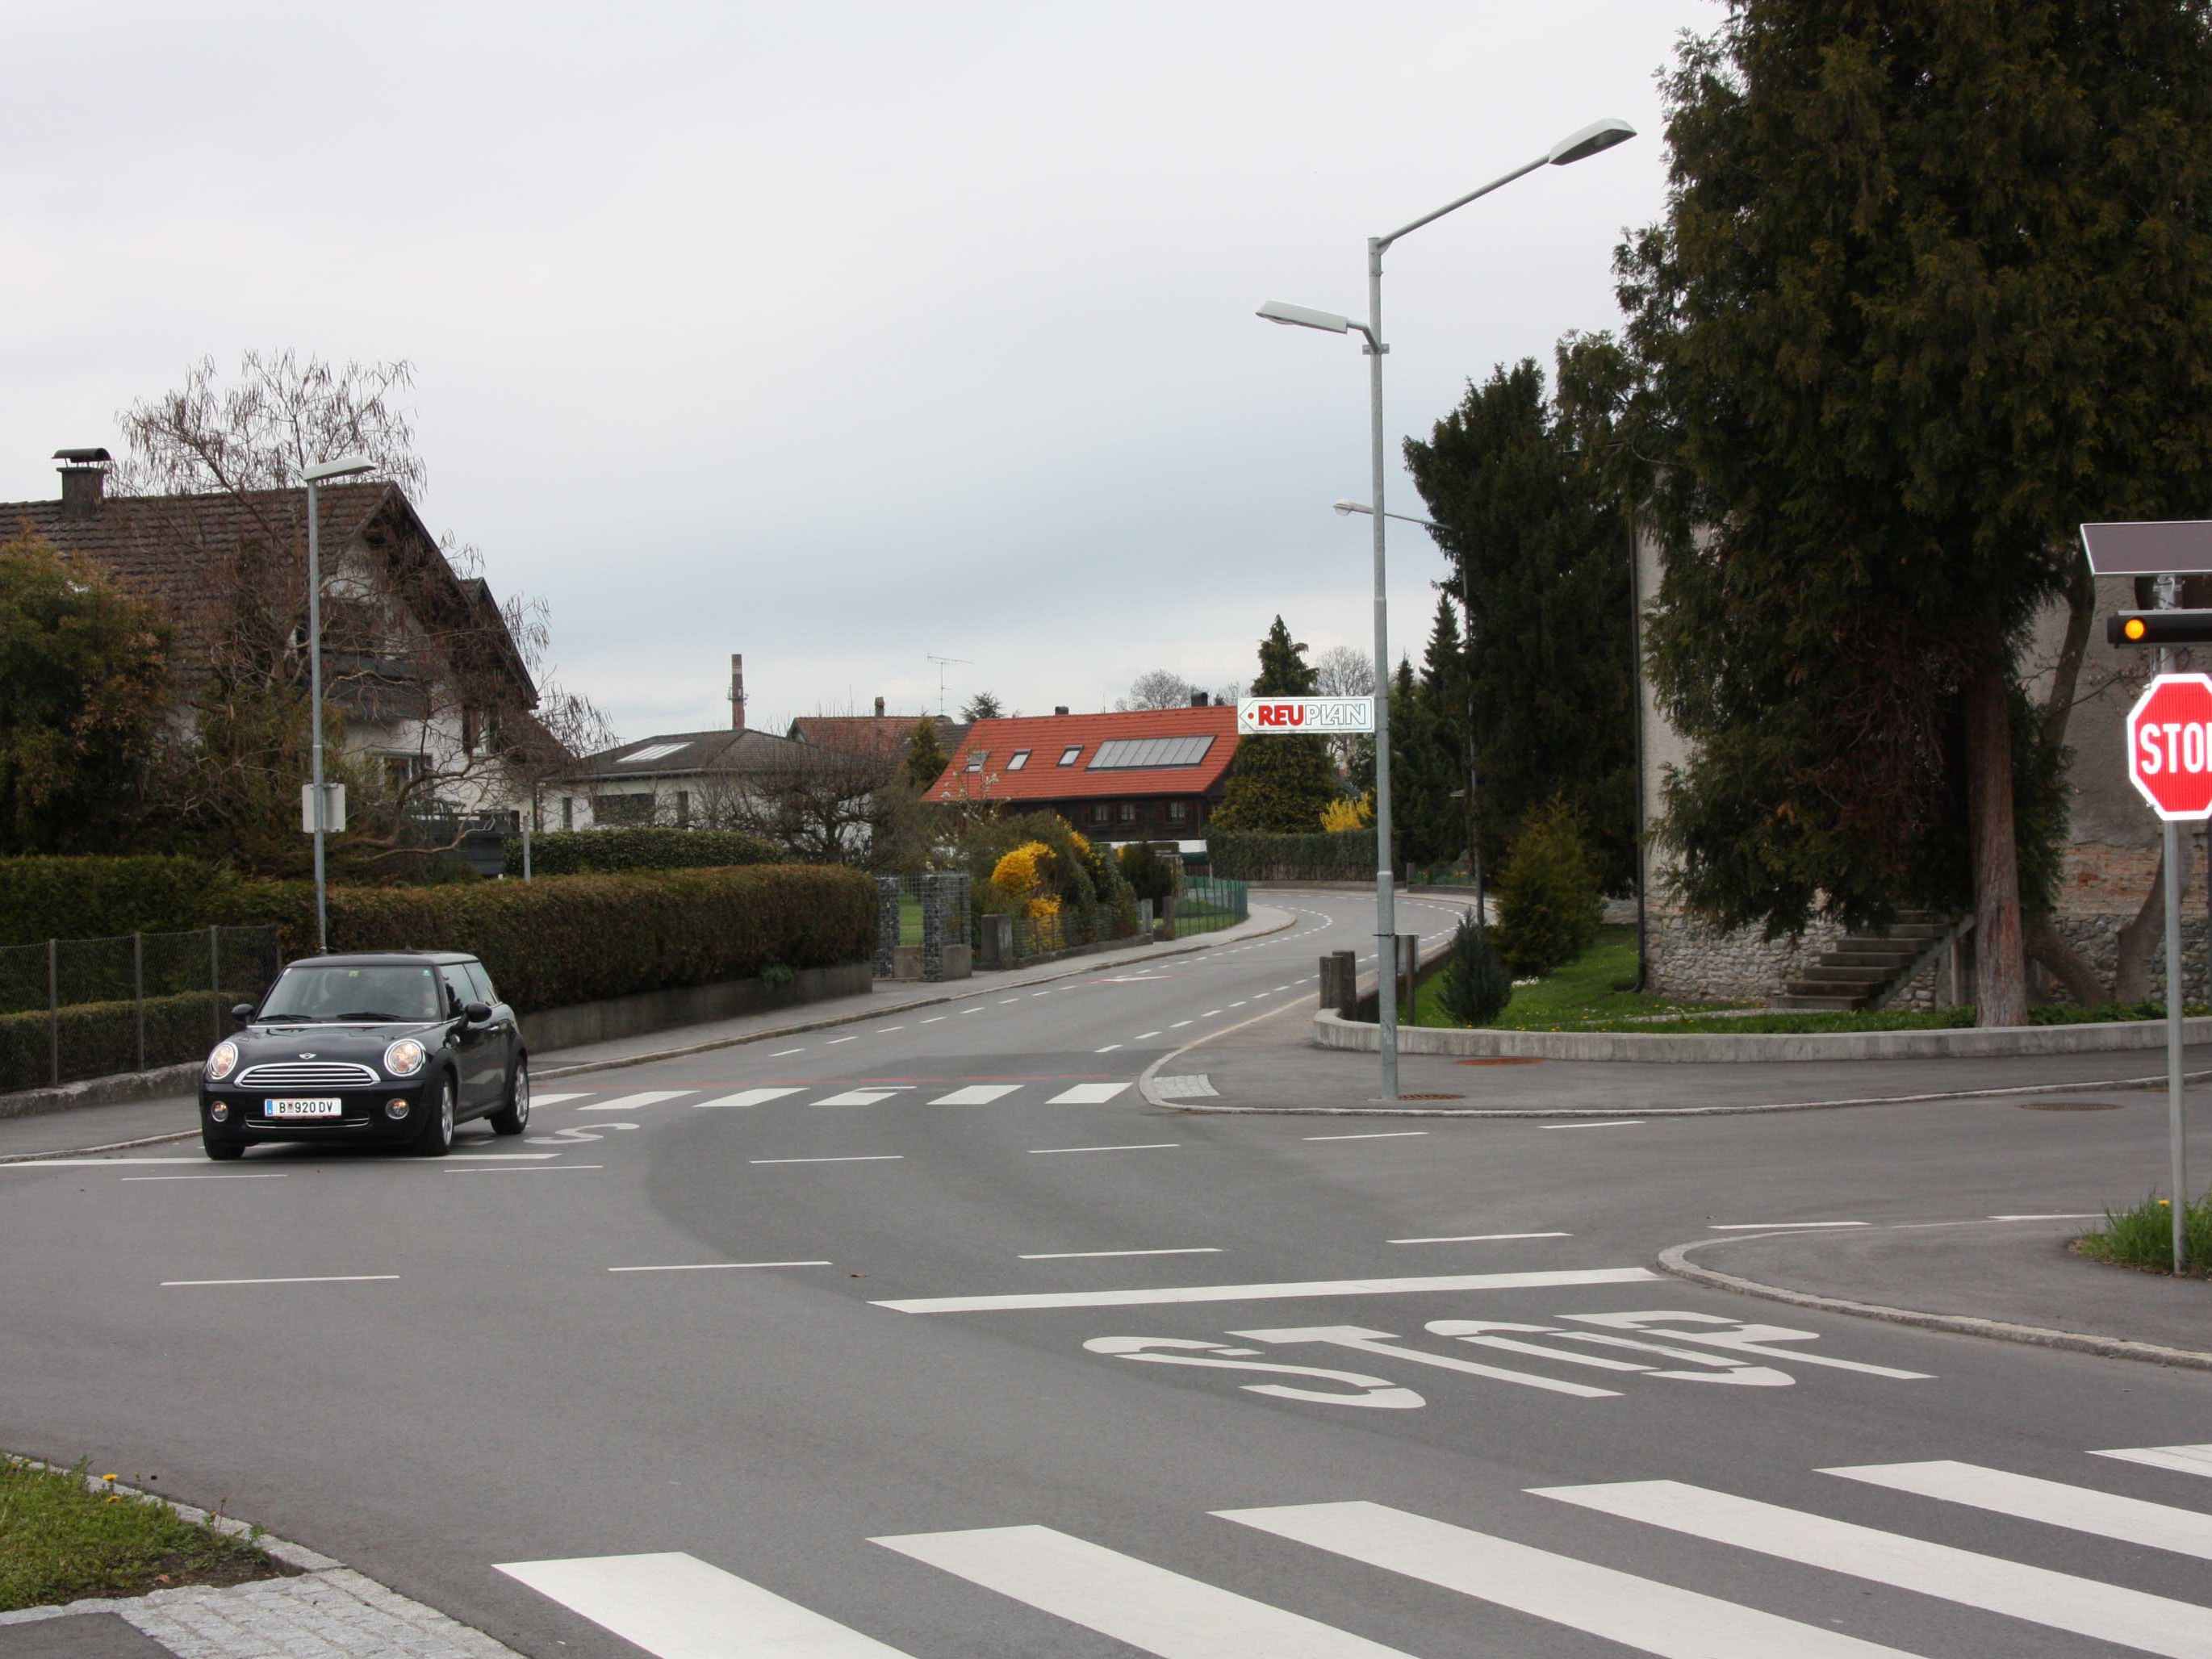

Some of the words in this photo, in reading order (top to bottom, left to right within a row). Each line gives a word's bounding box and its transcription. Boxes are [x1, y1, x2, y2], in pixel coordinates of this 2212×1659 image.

[1258, 704, 1366, 725] REUPLAN
[279, 1102, 286, 1113] B
[295, 1102, 316, 1113] 920
[319, 1101, 332, 1112] DV
[1083, 1310, 1938, 1409] STOP
